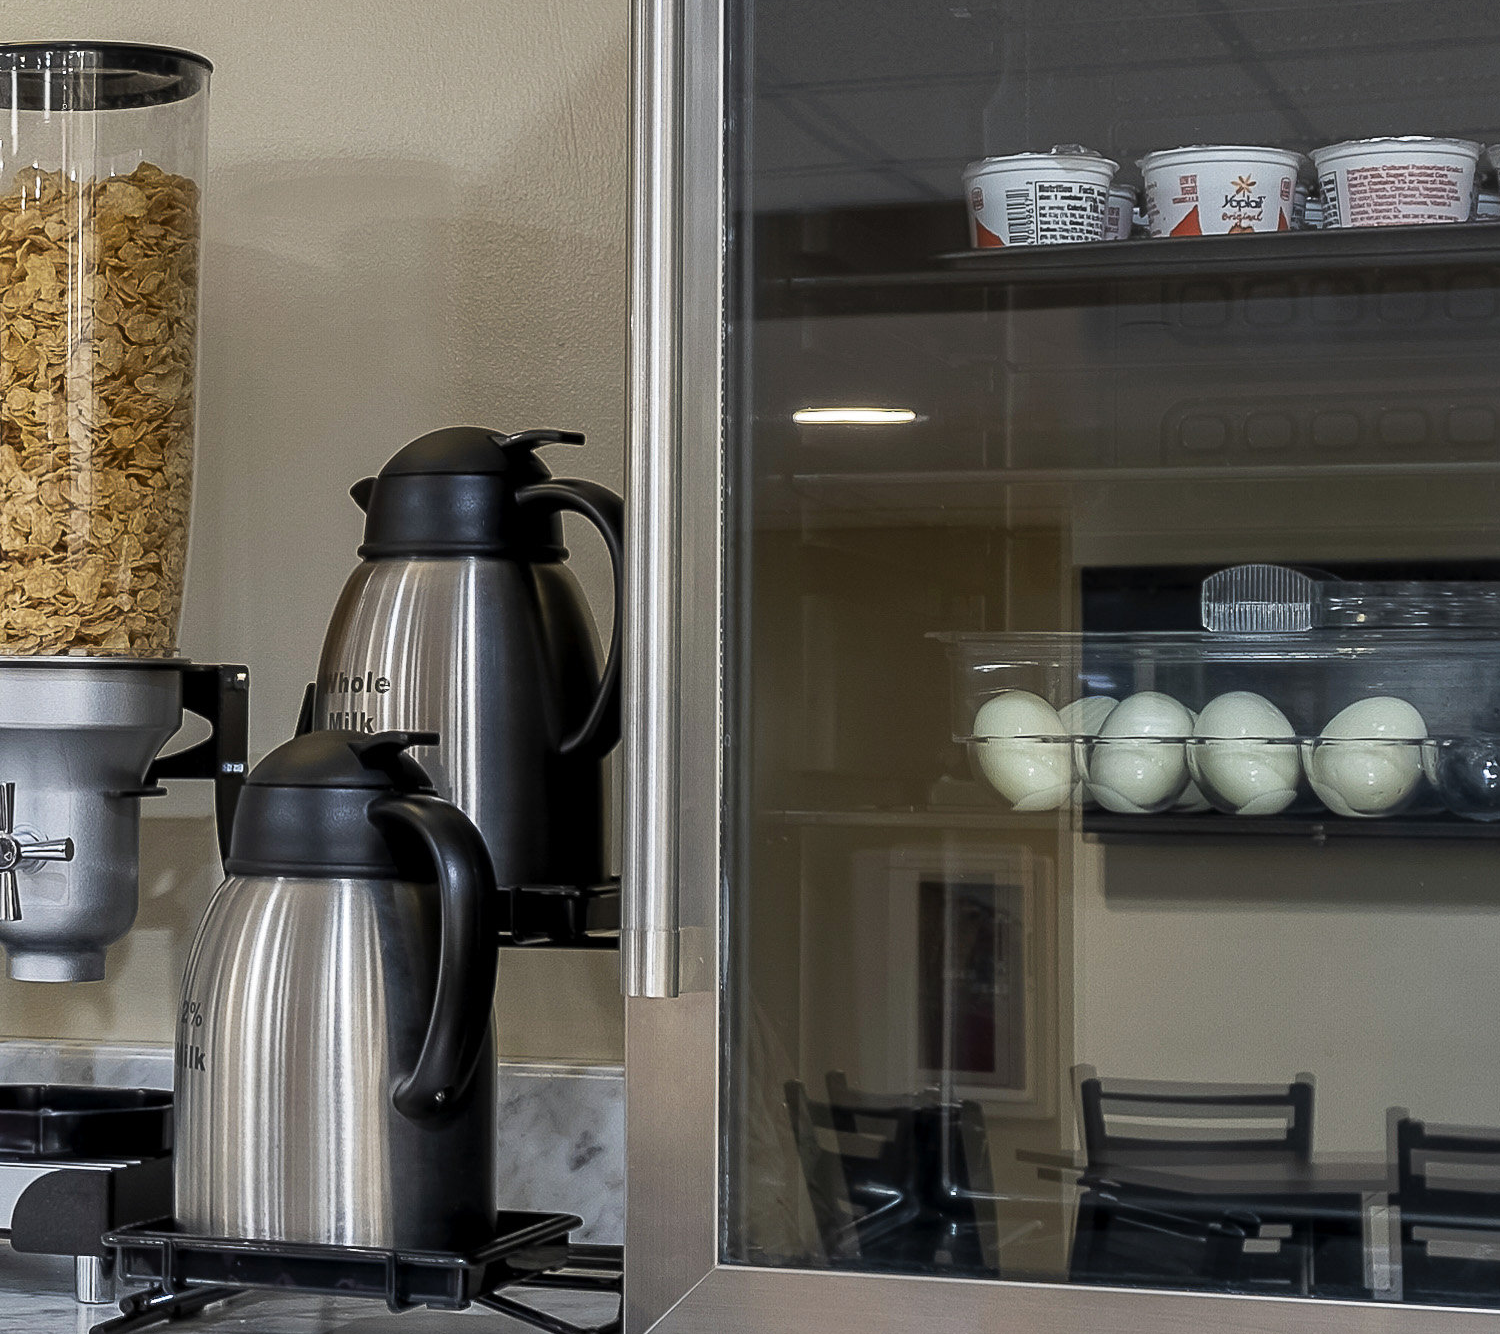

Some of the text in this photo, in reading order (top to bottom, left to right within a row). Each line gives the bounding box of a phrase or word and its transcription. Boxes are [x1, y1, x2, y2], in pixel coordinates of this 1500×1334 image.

[1221, 210, 1263, 224] Original
[329, 712, 374, 733] Milk
[181, 1000, 203, 1027] 2%
